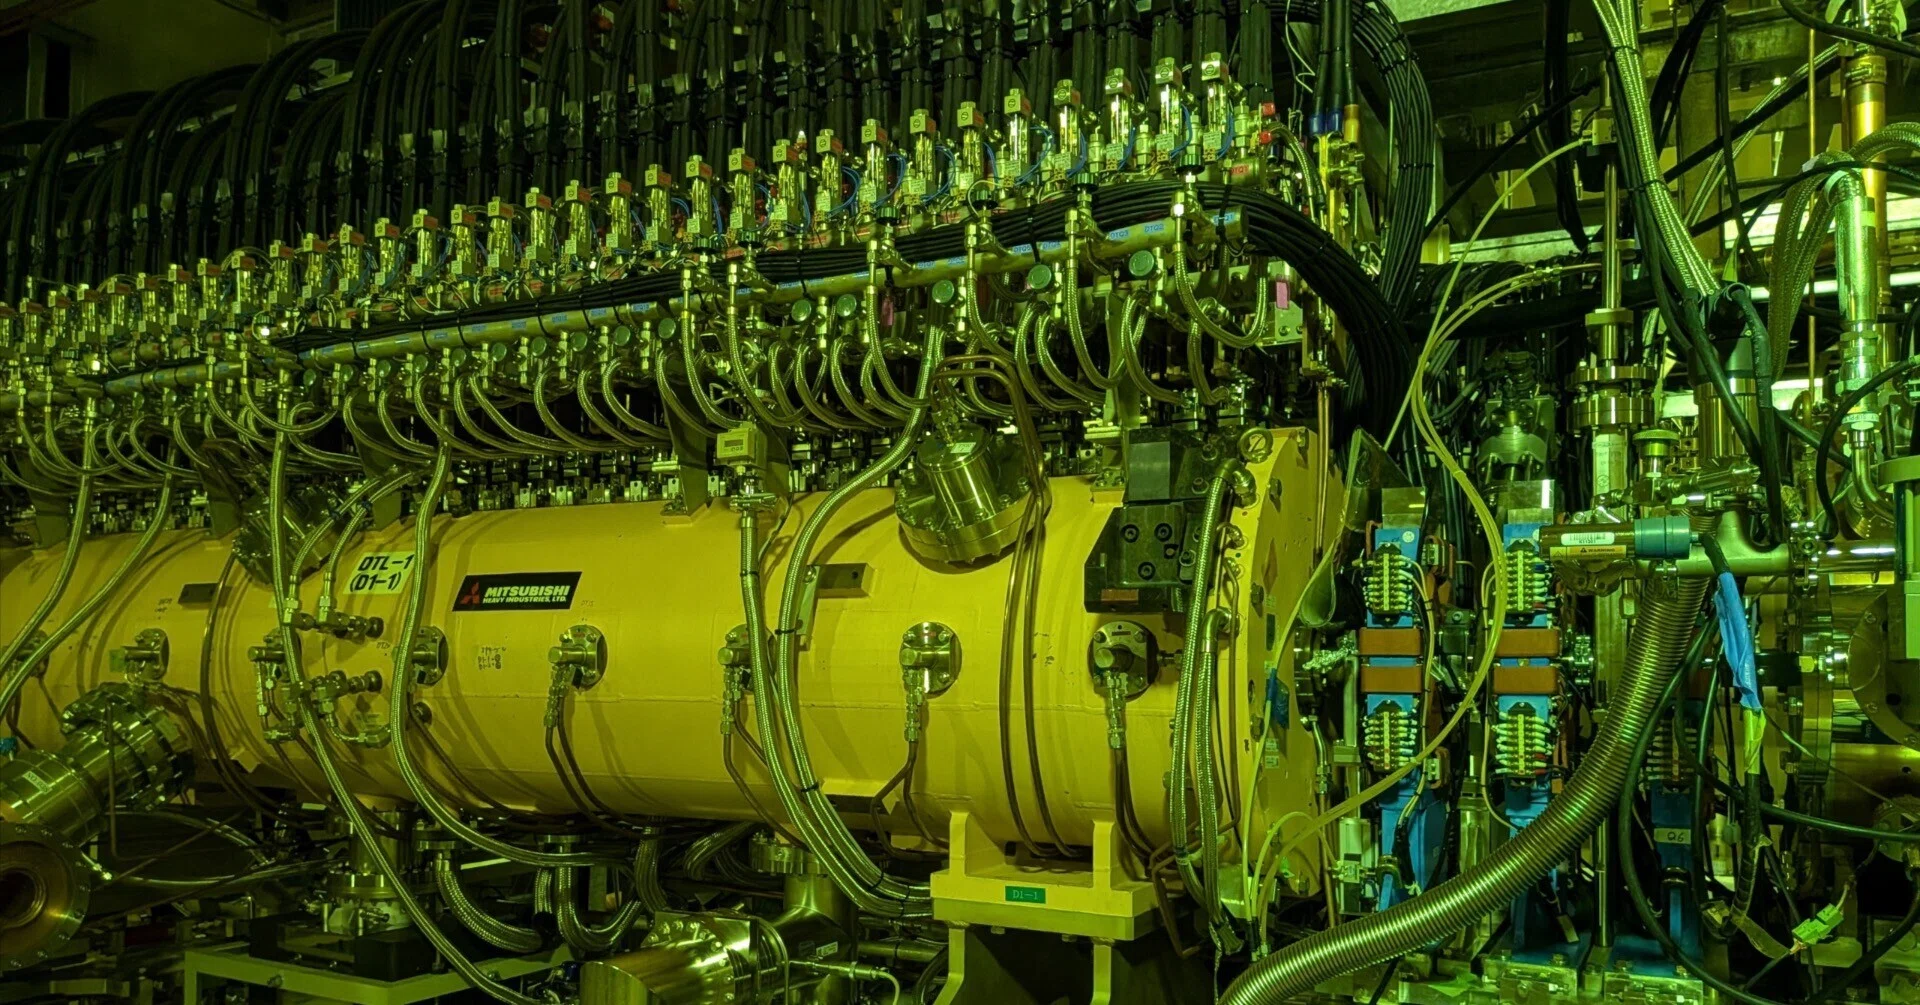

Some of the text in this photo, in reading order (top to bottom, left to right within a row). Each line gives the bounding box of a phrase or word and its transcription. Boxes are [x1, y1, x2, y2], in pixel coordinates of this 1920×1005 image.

[358, 554, 414, 571] DTL-1
[350, 572, 401, 592] (D1-1)
[484, 585, 570, 597] MITSUBISHI
[1012, 889, 1038, 900] D1-1
